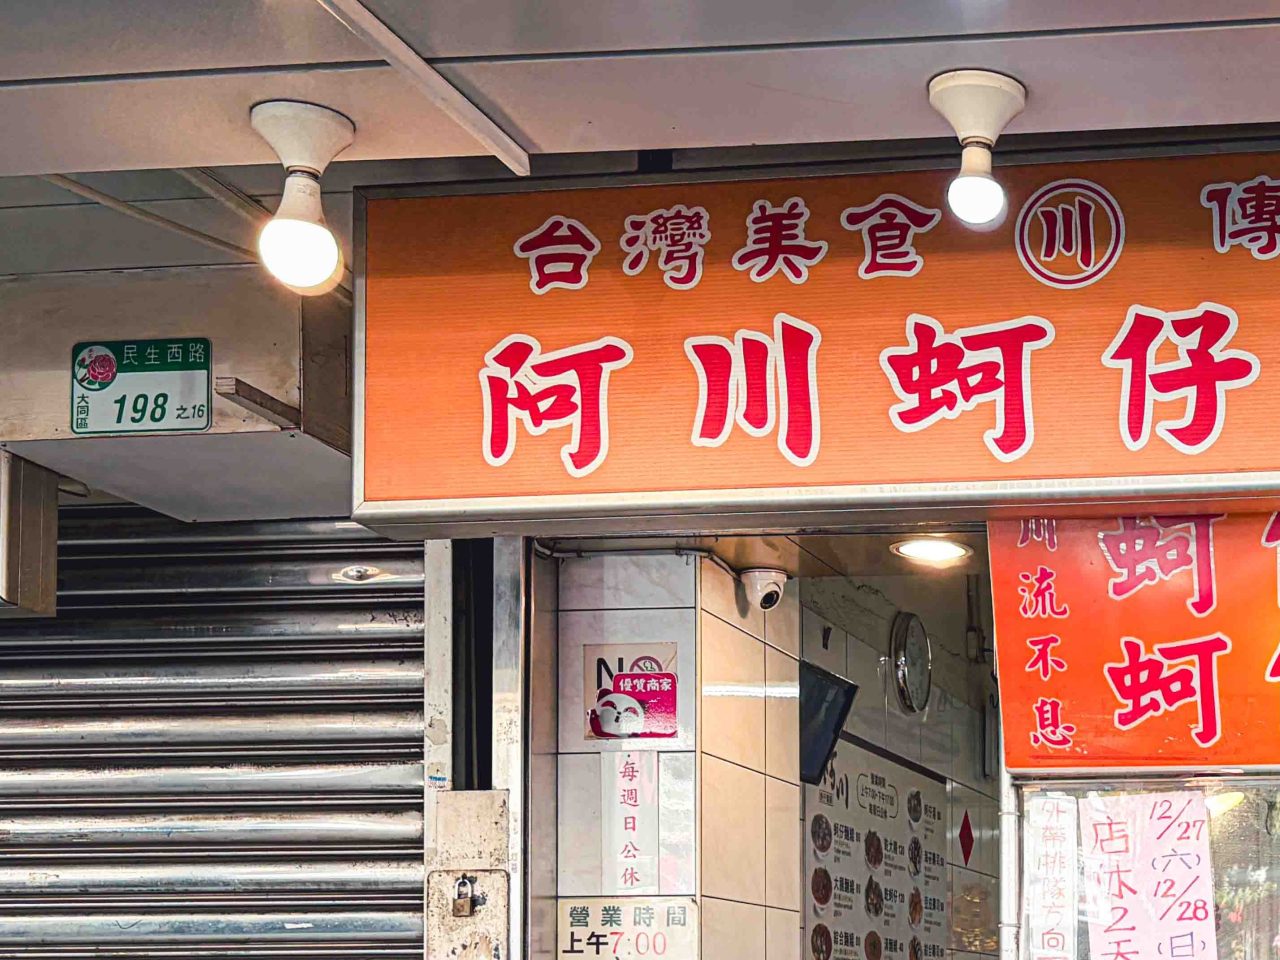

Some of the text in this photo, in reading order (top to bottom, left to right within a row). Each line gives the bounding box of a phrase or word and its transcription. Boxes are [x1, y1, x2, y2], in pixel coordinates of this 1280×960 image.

[514, 193, 940, 294] 台灣美食
[122, 342, 205, 366] 民生西路
[76, 393, 90, 430] 大同區
[113, 392, 206, 425] 198 之16
[618, 677, 673, 692] 優質商家
[618, 760, 641, 888] 每週日公休
[1149, 798, 1206, 841] 12/27
[569, 905, 688, 928] 營業時間
[1153, 875, 1210, 922] 12/28
